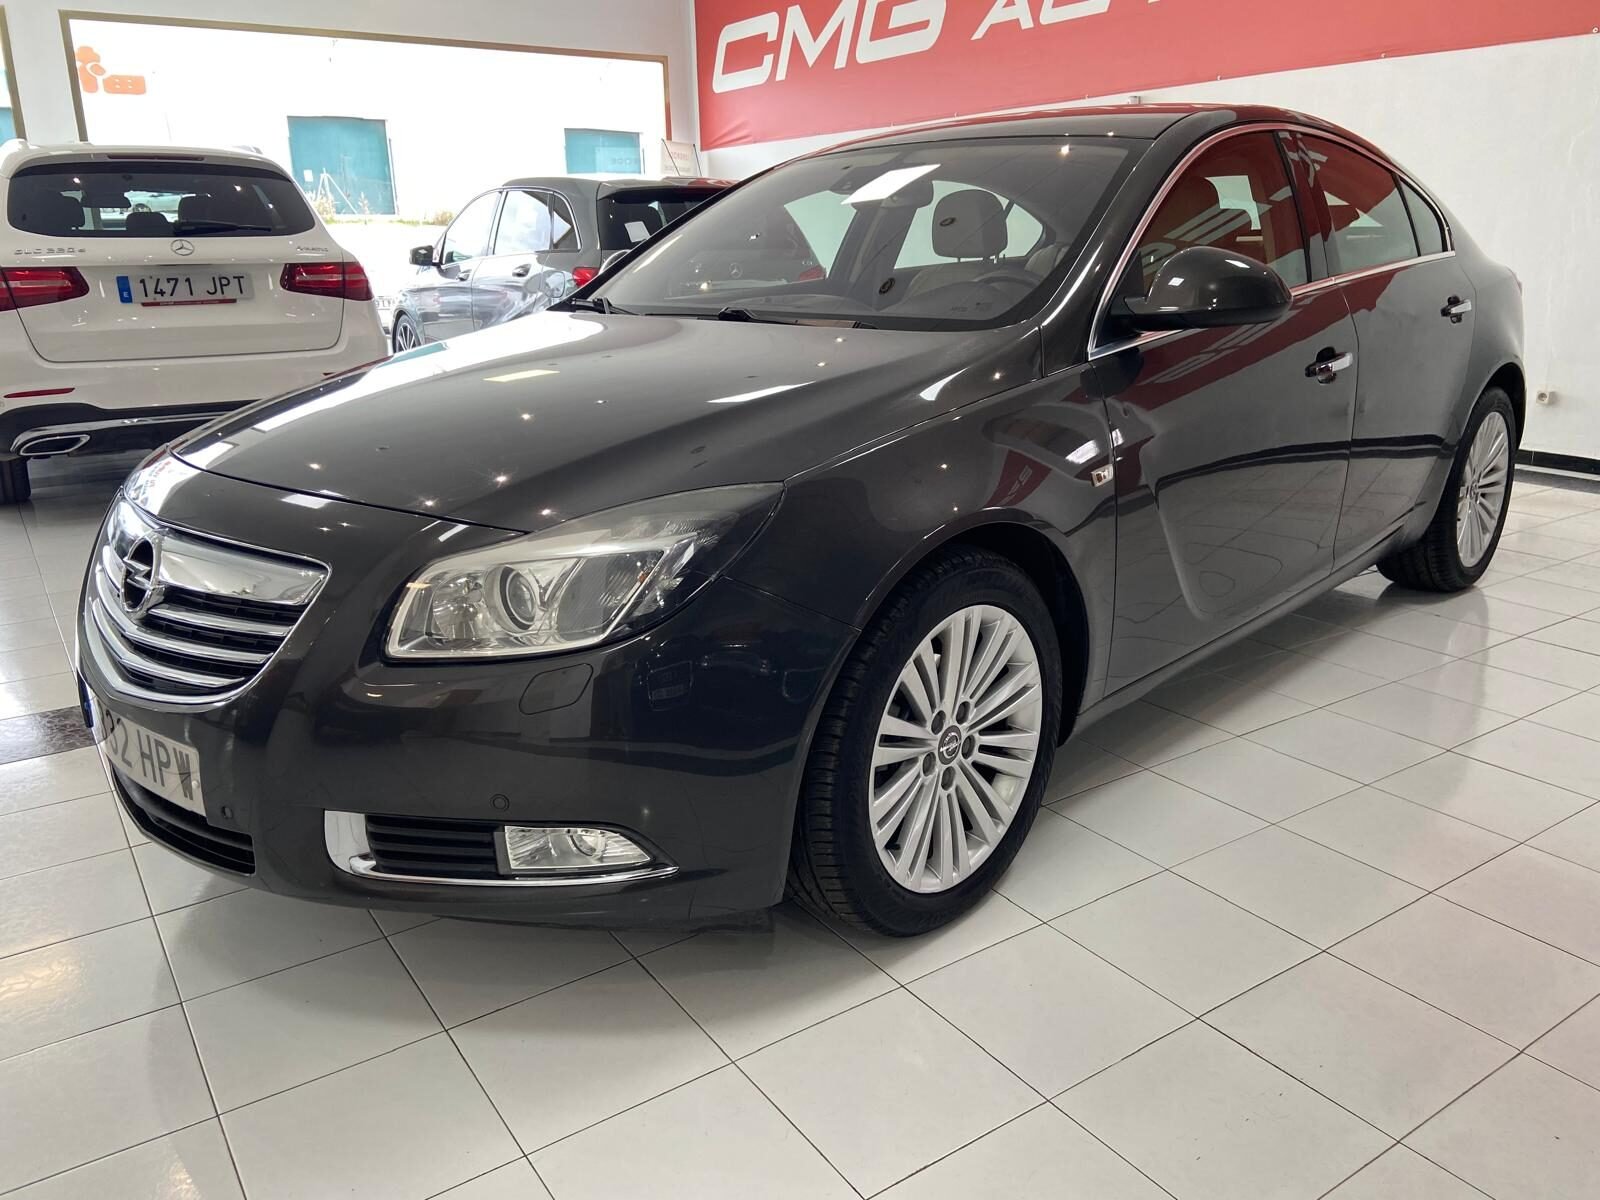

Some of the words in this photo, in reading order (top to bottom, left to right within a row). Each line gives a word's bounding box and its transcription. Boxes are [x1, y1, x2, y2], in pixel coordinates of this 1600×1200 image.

[713, 0, 947, 93] CMG
[140, 277, 194, 298] 1471
[206, 276, 244, 296] JPT
